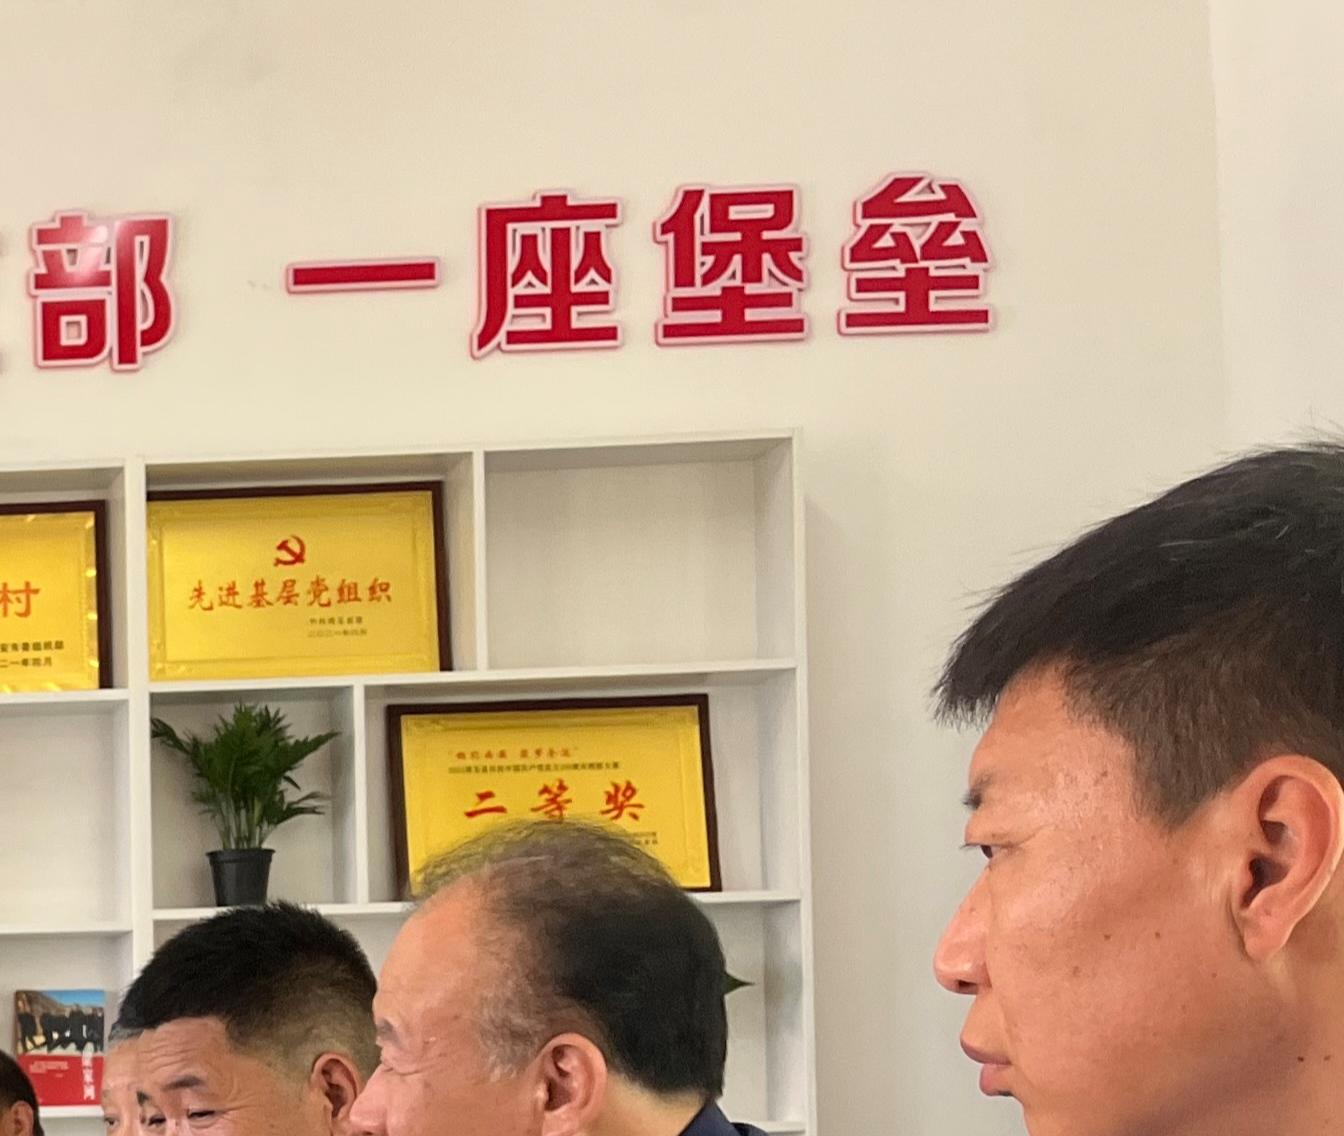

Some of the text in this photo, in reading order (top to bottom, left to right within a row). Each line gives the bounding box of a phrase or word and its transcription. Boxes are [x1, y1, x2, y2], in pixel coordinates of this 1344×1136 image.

[283, 173, 996, 362] 一座堡垒
[188, 574, 393, 612] 先进基层党组织
[464, 778, 646, 823] 二等奖
